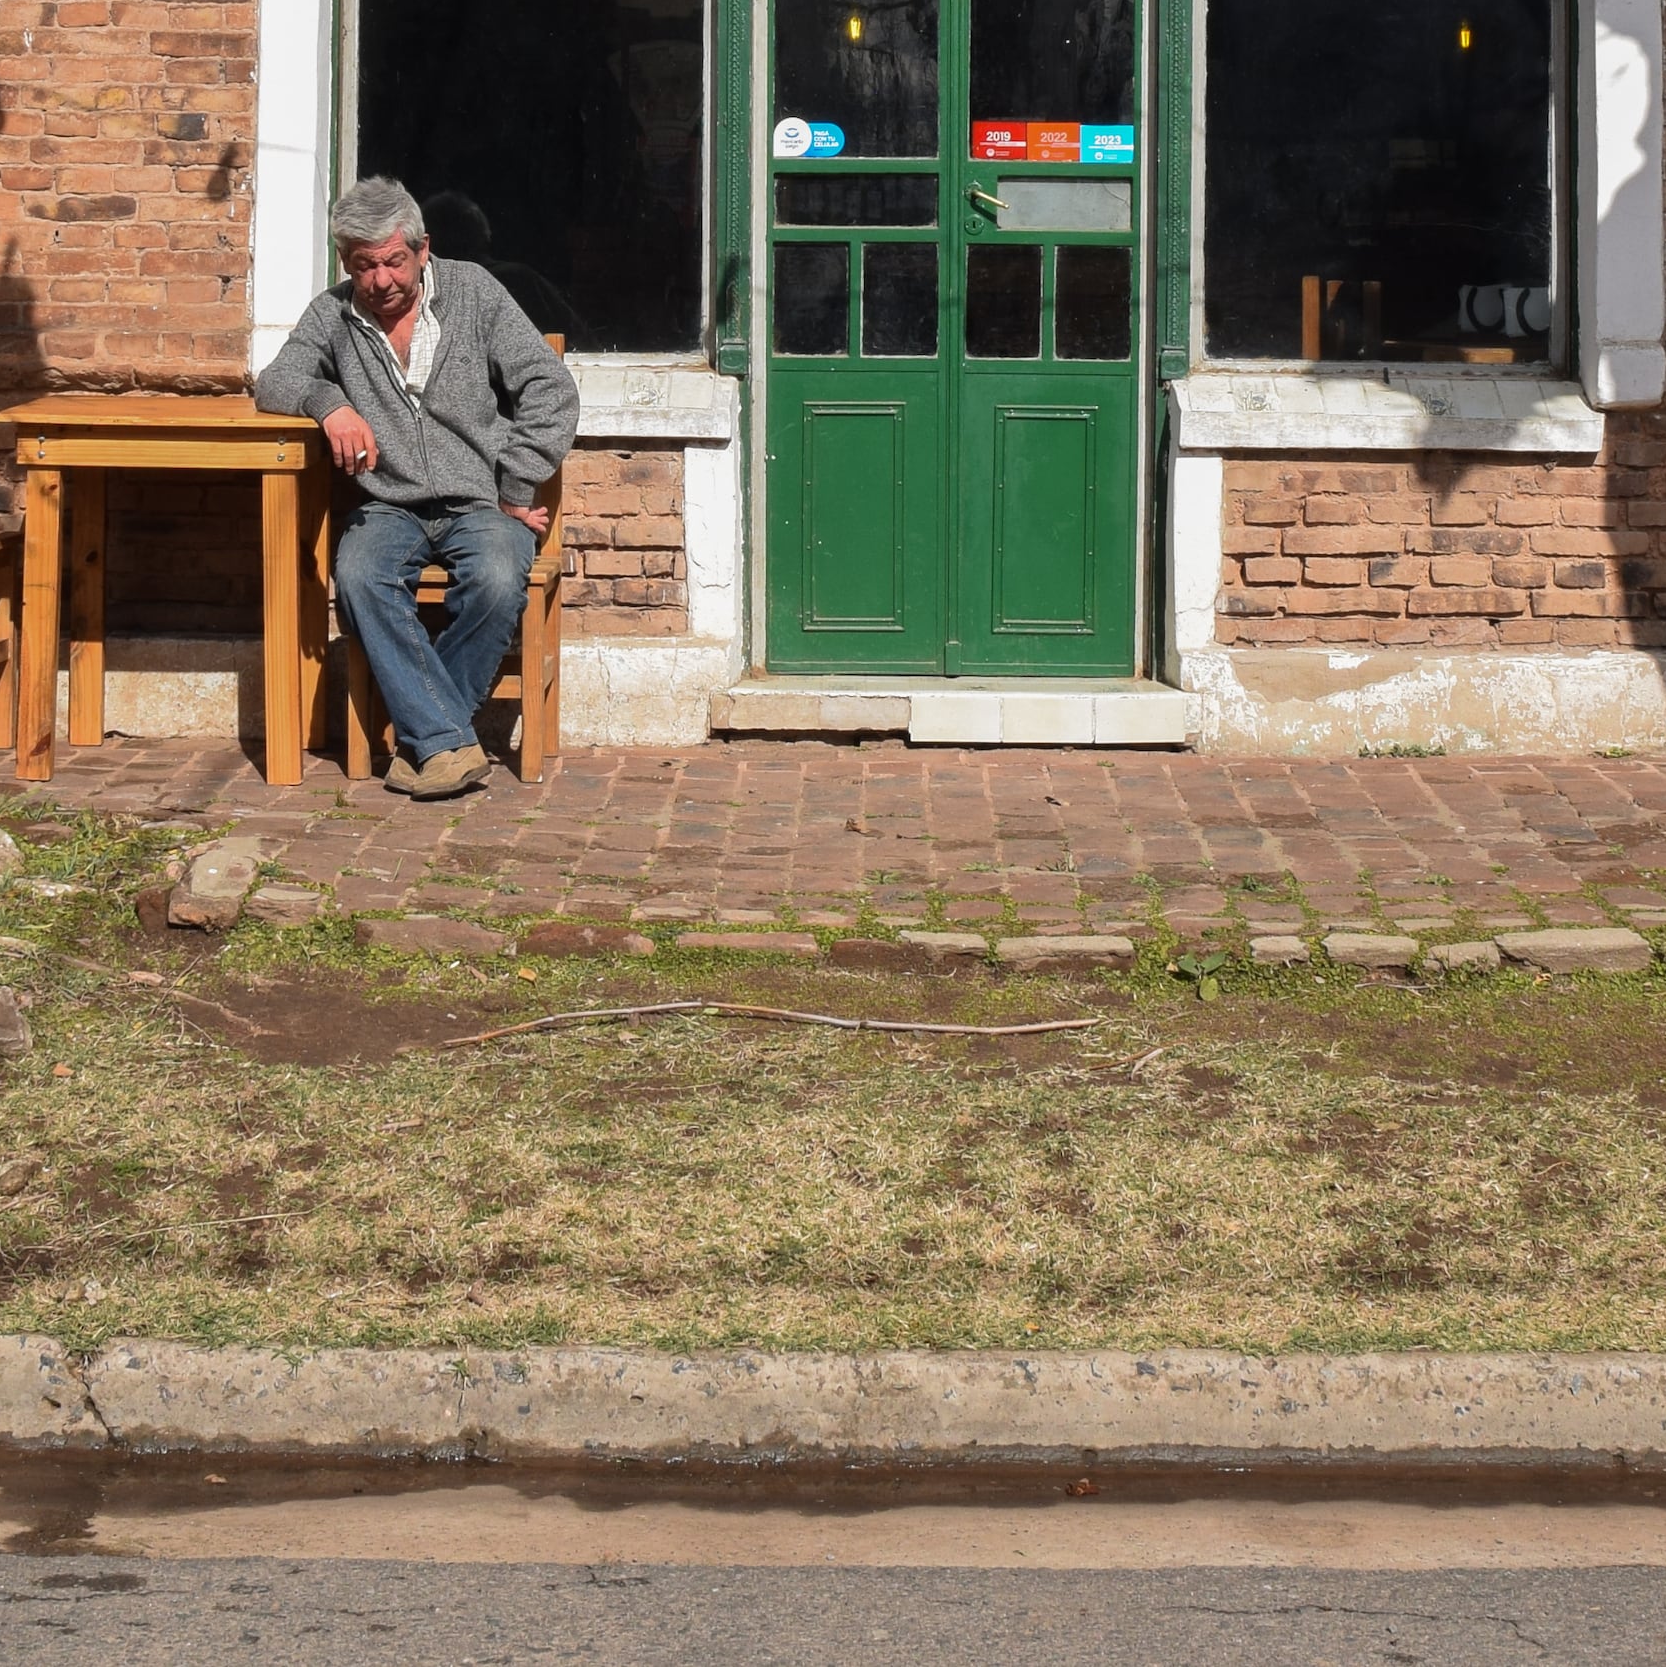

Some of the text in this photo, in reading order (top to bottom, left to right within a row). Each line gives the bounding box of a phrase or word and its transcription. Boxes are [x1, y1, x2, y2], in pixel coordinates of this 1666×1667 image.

[986, 131, 1012, 142] 2019
[1040, 132, 1068, 143] 2022
[1094, 135, 1122, 145] 2023
